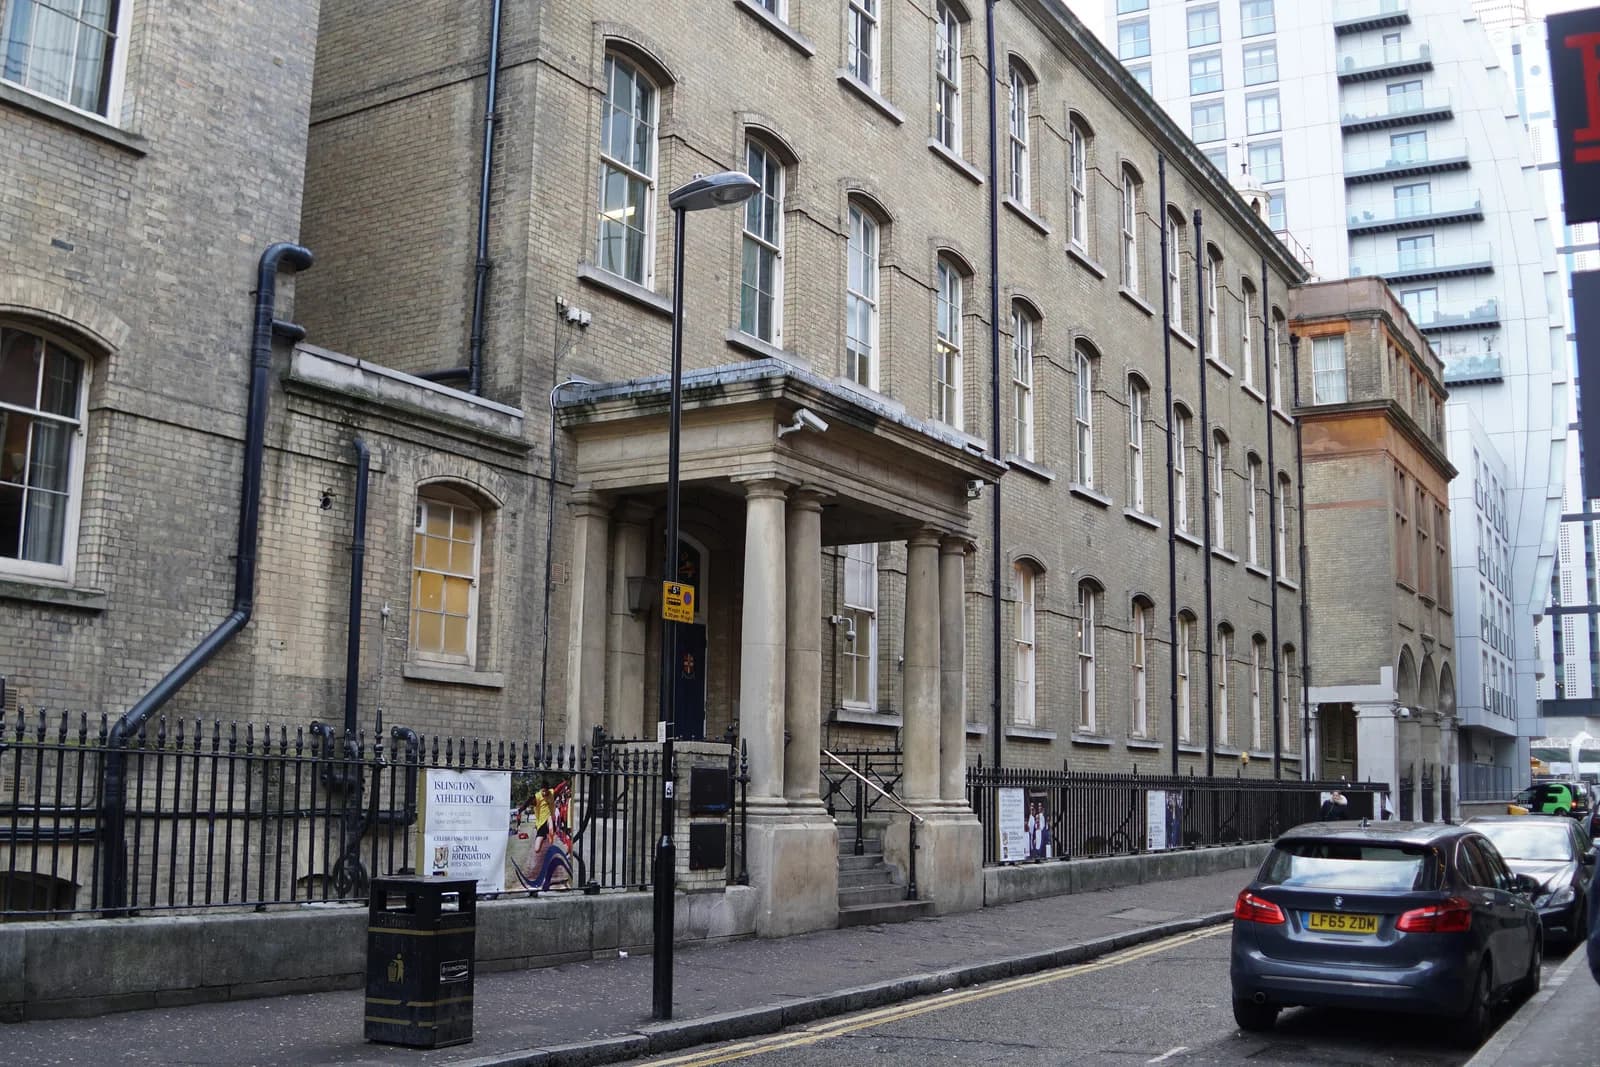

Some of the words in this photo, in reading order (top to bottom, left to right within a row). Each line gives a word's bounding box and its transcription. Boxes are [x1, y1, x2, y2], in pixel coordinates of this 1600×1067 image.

[434, 780, 476, 791] ISLINGTON
[435, 793, 474, 804] ATHLETICS
[476, 794, 494, 804] CUP
[451, 853, 491, 861] FOUNDATION
[1311, 914, 1346, 928] LF65
[1349, 916, 1376, 930] ZDM
